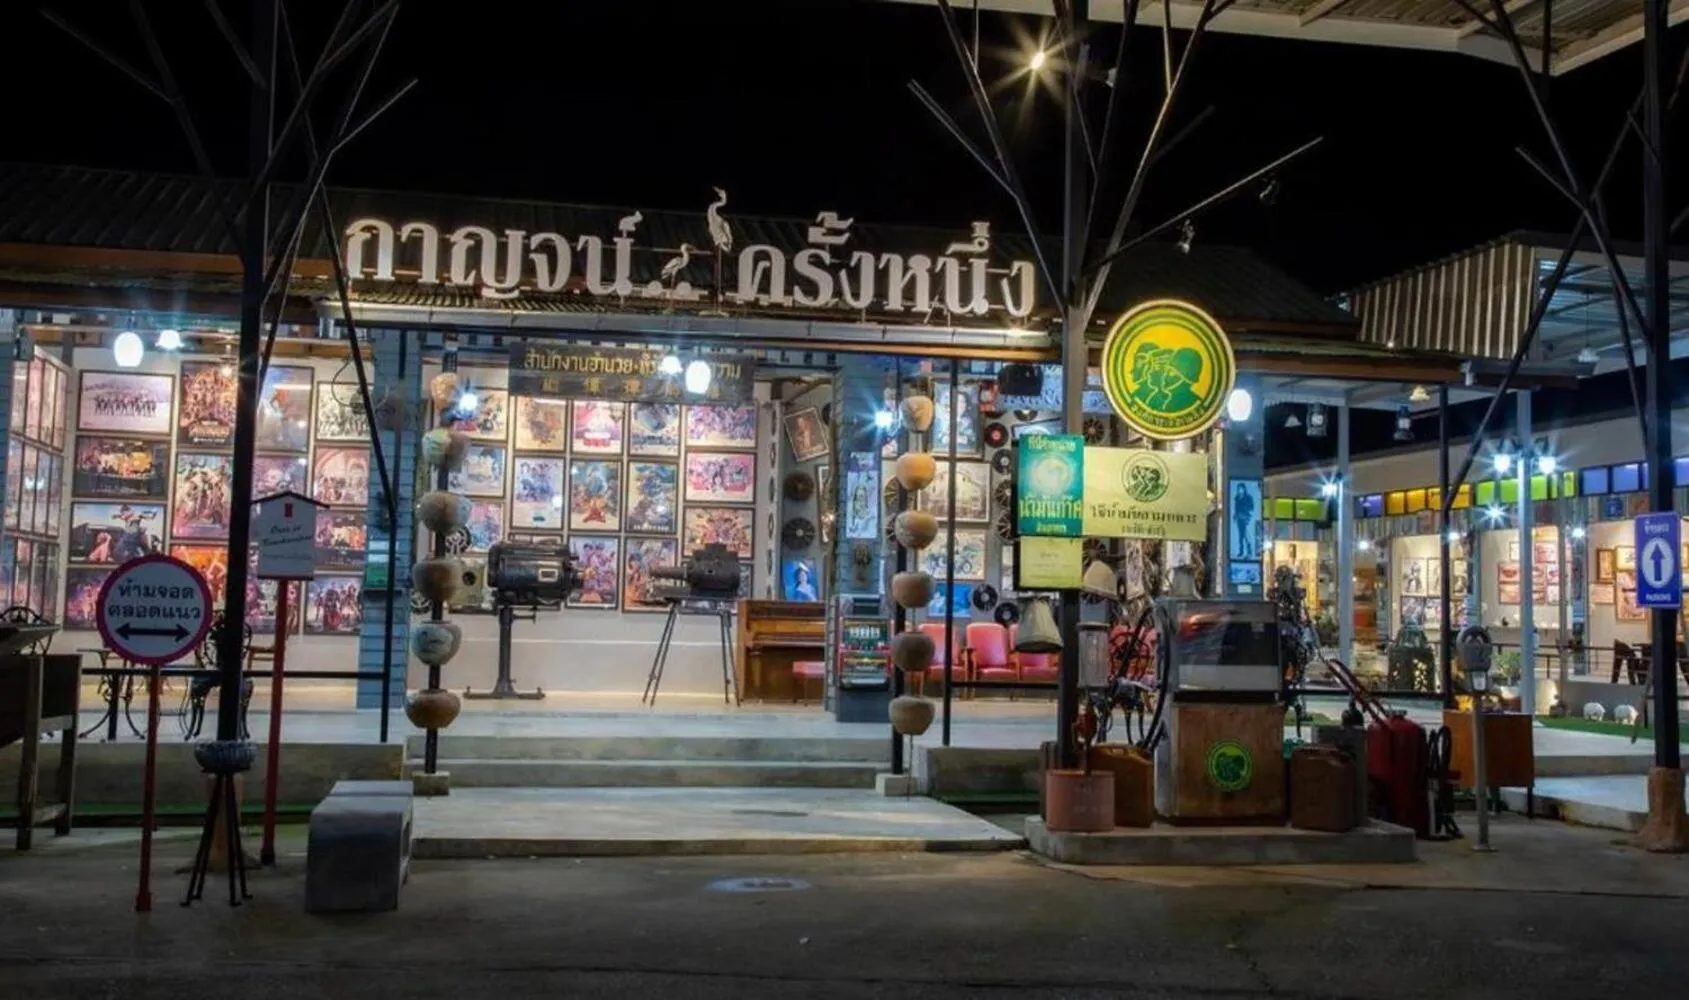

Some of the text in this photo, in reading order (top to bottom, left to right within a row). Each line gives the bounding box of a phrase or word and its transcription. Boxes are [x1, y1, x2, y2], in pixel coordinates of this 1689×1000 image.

[737, 211, 1036, 317] ครั้งหนึ่ง
[118, 578, 195, 600] ห้ามจอด
[107, 604, 201, 620] ตลอดแนว
